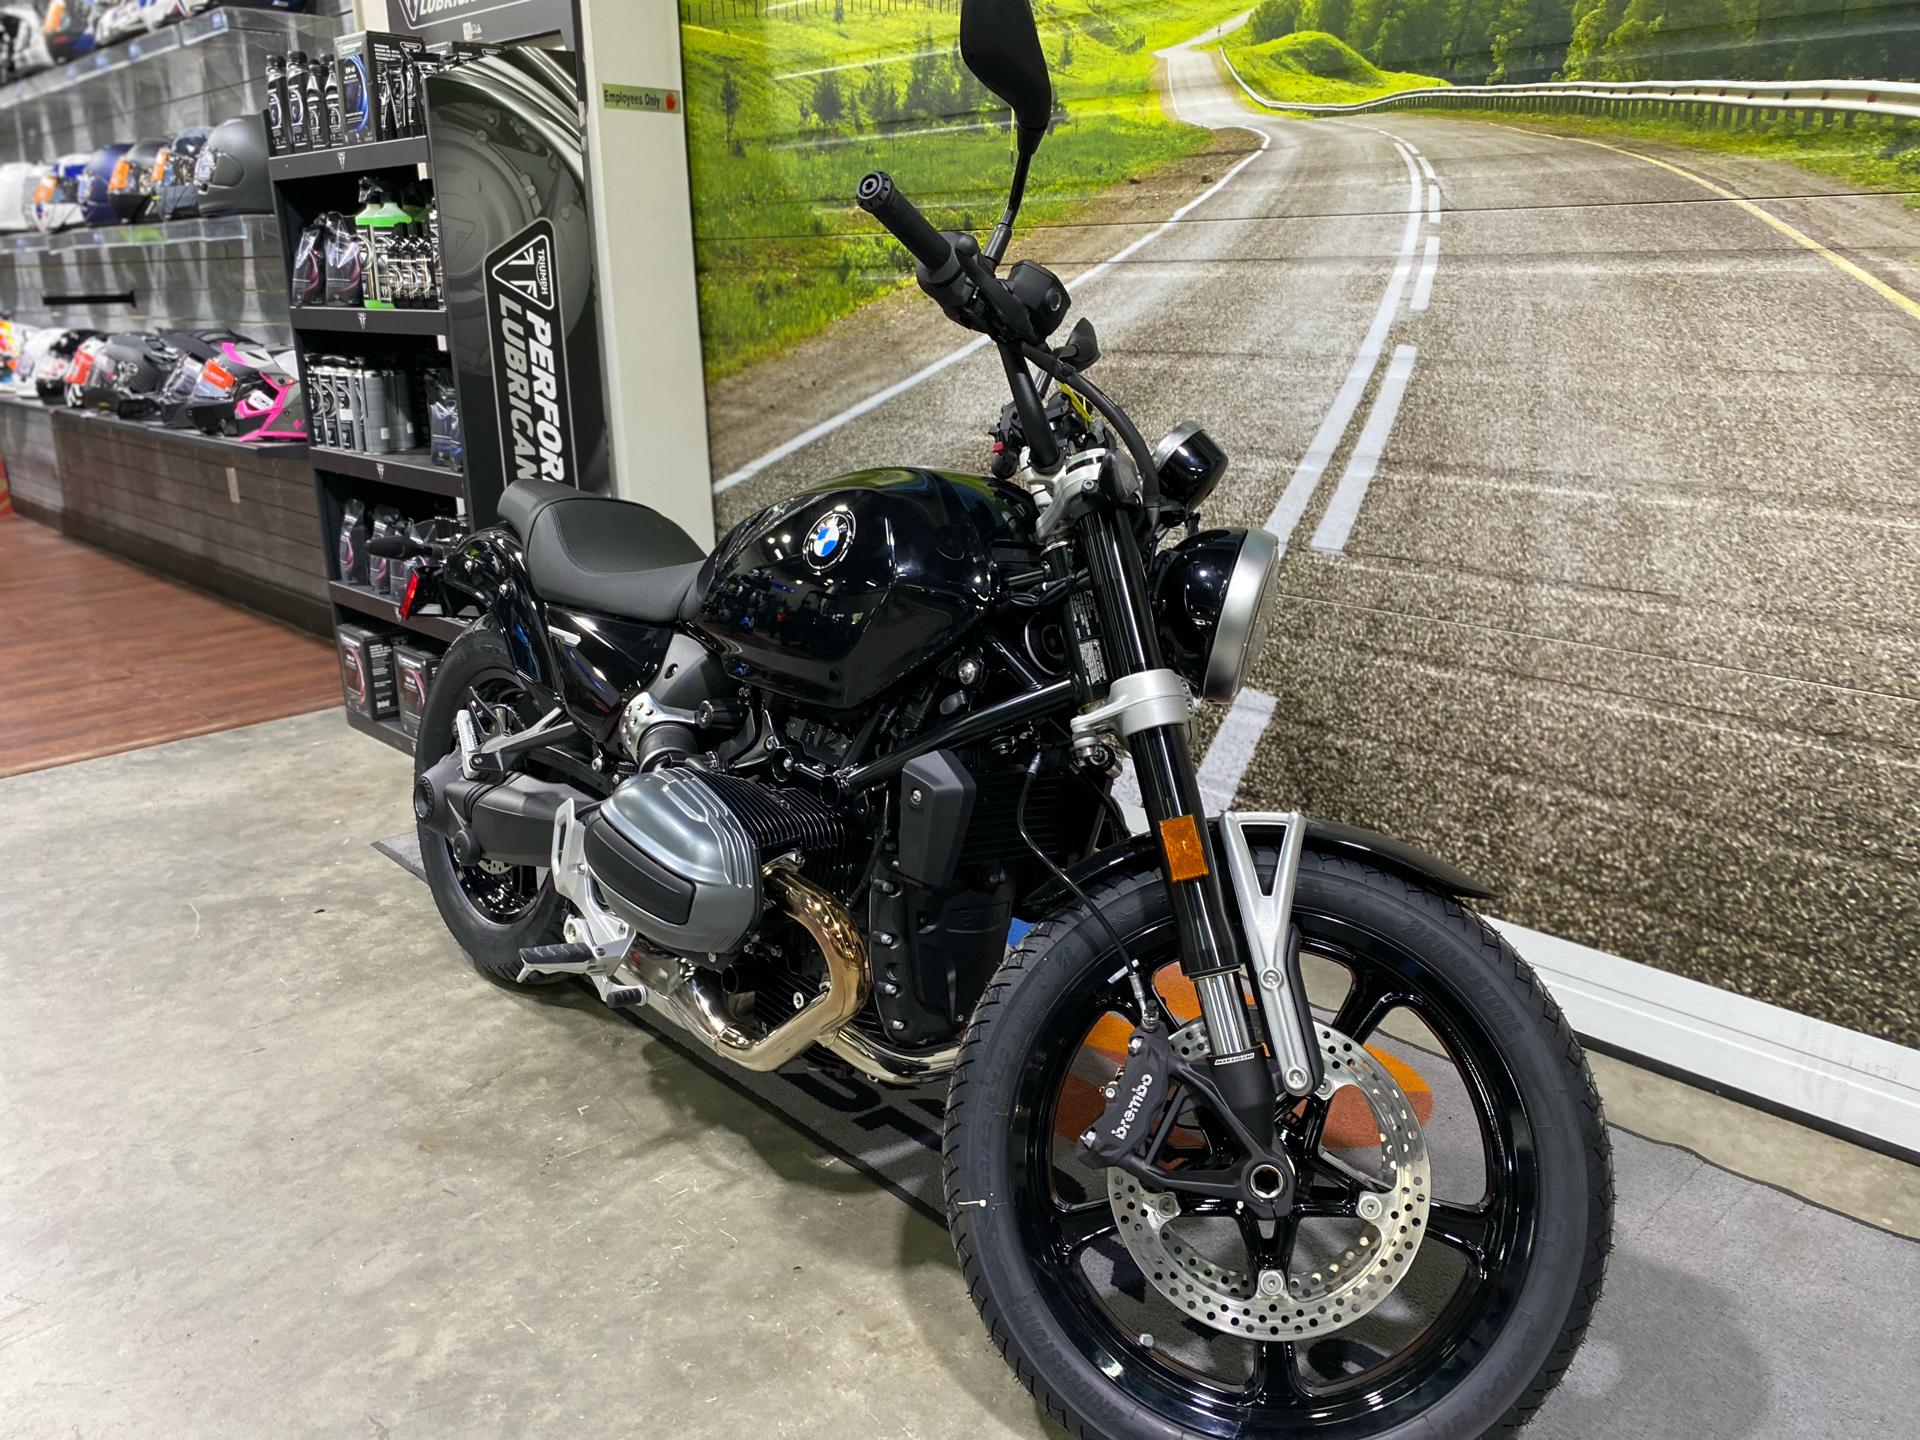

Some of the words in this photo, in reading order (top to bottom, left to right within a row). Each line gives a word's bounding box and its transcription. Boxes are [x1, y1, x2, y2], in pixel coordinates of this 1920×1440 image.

[604, 90, 643, 107] Employees
[644, 93, 660, 109] Only
[537, 248, 549, 295] TRIUMPH
[526, 309, 565, 482] PERFOR
[1402, 920, 1526, 1036] BRIDGESTONE
[1215, 1054, 1254, 1065] MARZOCCHI
[1111, 1074, 1153, 1140] brembo
